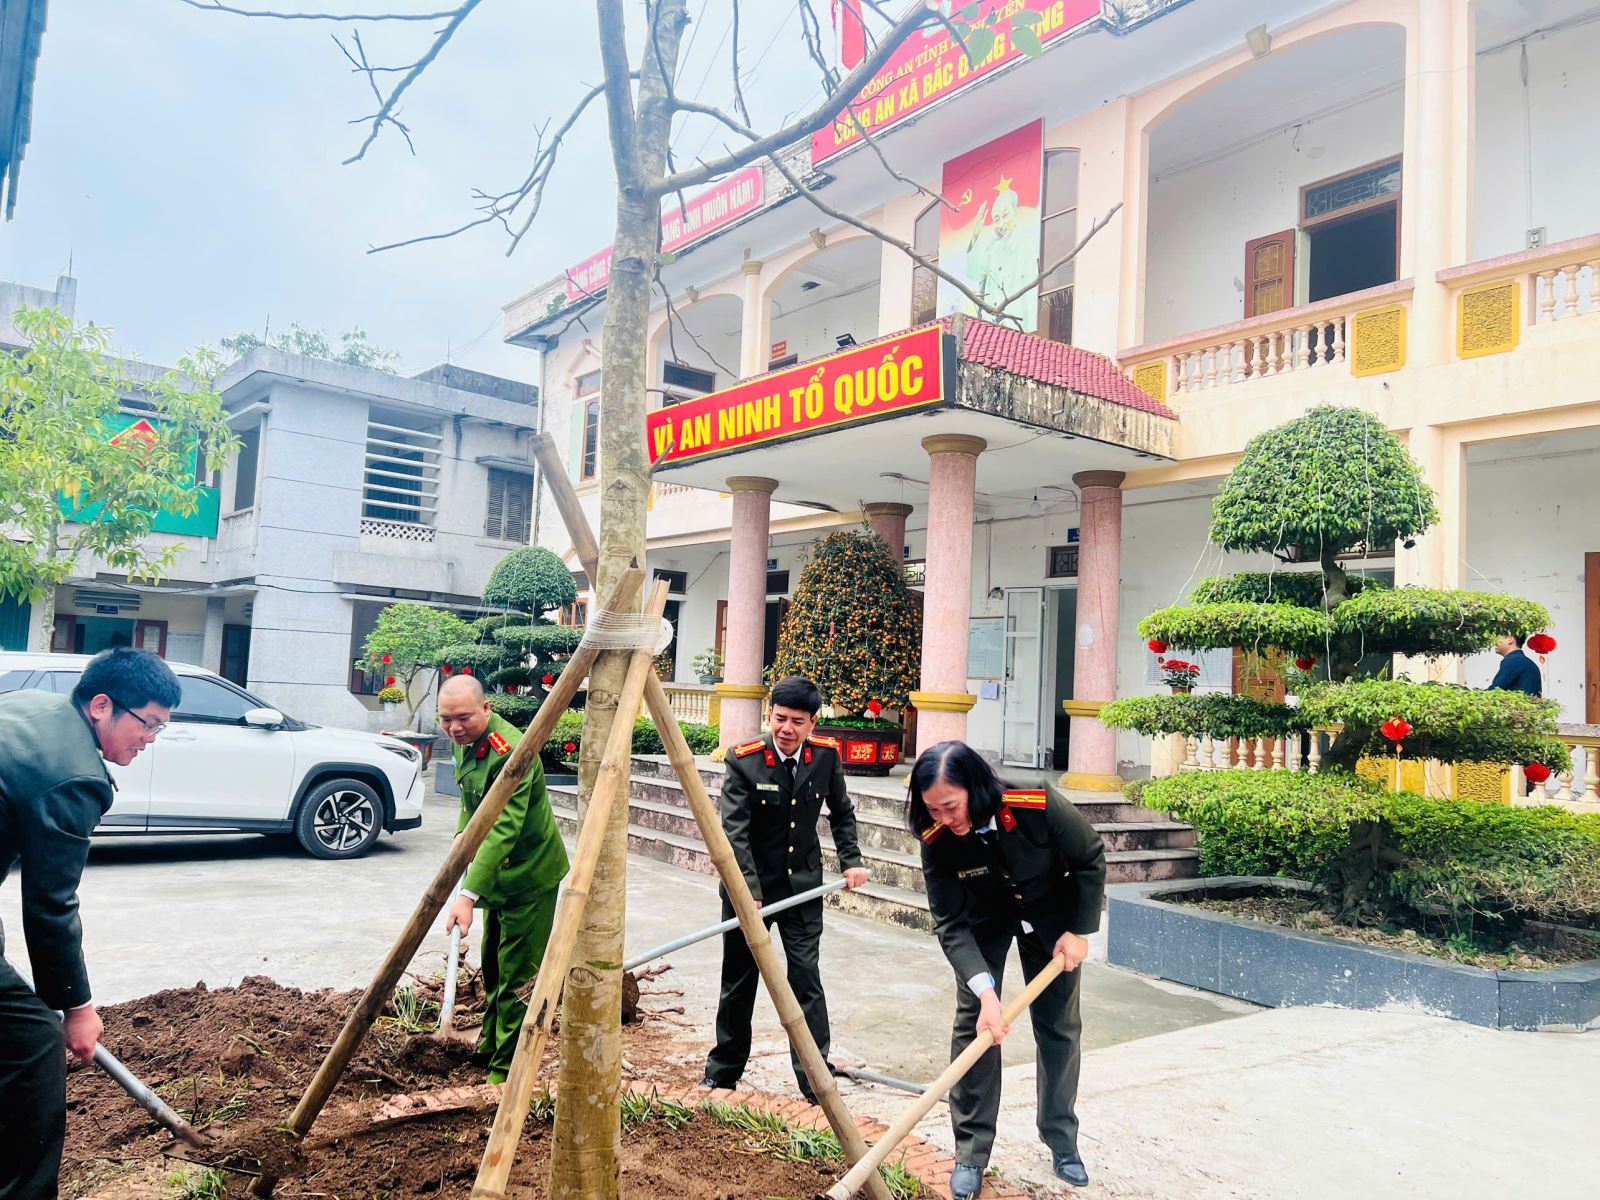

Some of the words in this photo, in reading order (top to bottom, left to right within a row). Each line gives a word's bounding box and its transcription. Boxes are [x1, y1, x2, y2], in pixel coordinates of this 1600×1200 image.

[874, 93, 895, 125] AN
[898, 78, 919, 112] XÃ
[923, 56, 953, 99] BẮC
[679, 413, 711, 451] AN
[718, 394, 781, 442] NINH
[788, 366, 824, 424] TỔ
[834, 345, 924, 416] QUỐC
